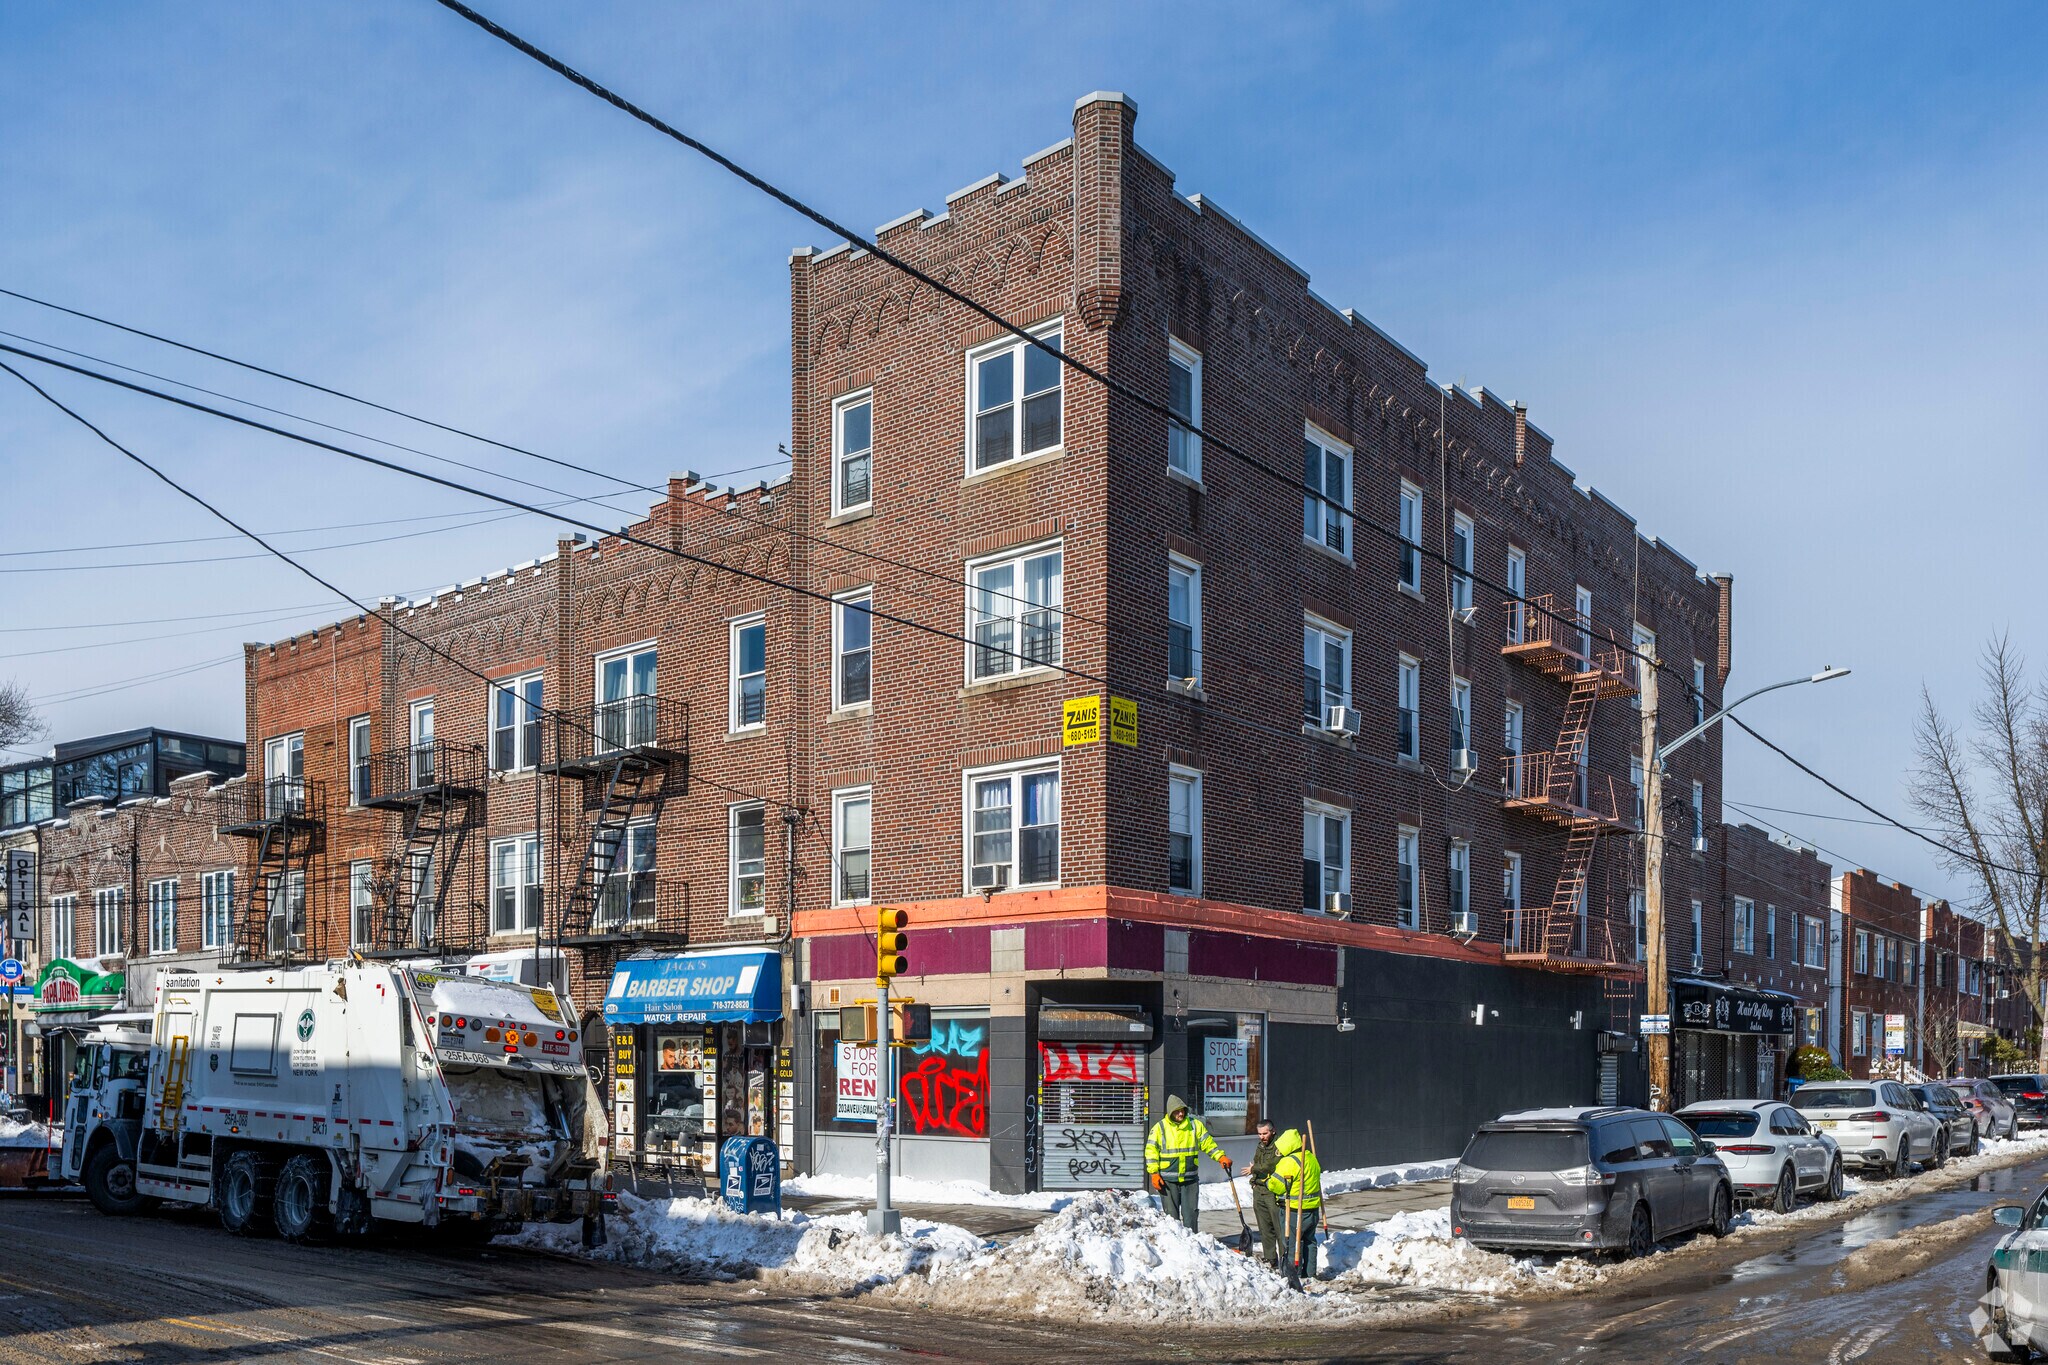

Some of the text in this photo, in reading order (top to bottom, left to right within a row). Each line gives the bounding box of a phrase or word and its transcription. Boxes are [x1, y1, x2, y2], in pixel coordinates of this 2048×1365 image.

[1067, 708, 1097, 729] ZANIS
[1112, 708, 1136, 731] ZANIS
[165, 977, 200, 988] sanitation
[626, 976, 735, 998] BARBER SHOP
[42, 982, 58, 1003] PAPA
[644, 1003, 661, 1012] Hair
[644, 1013, 707, 1022] WATCH REPAIR
[617, 1036, 634, 1044] E & D
[619, 1050, 631, 1060] BUY
[704, 1047, 717, 1055] GOLD
[781, 1049, 790, 1057] WE
[844, 1046, 877, 1060] STOR
[1209, 1041, 1243, 1056] STORE
[446, 1051, 489, 1064] 25FA-068
[617, 1064, 634, 1074] GOLD
[852, 1062, 877, 1076] FOR
[1216, 1058, 1237, 1072] FOR
[840, 1078, 876, 1097] REN
[1206, 1074, 1245, 1093] RENT
